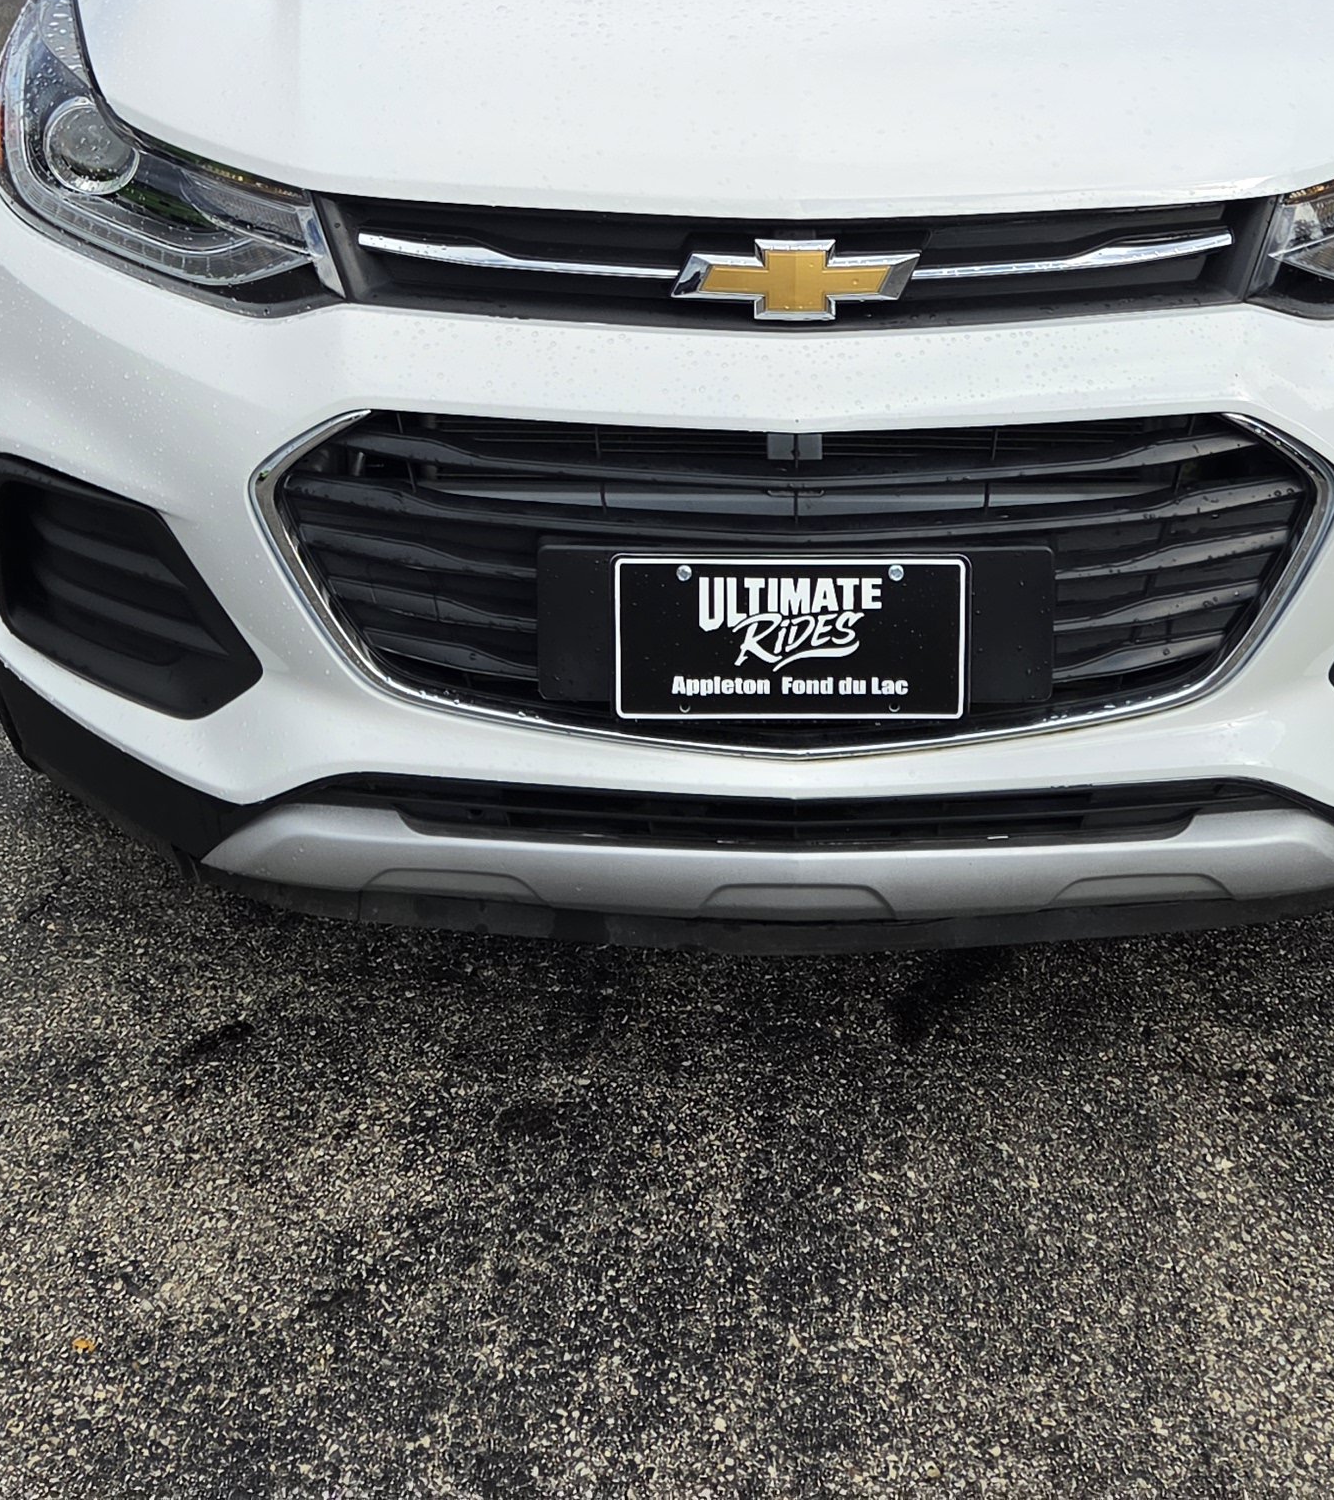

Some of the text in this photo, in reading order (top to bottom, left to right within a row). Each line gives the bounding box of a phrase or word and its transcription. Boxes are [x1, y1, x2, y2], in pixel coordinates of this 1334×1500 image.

[698, 576, 883, 632] ULTIMATE
[671, 675, 909, 696] Appleton Fond du Lac
